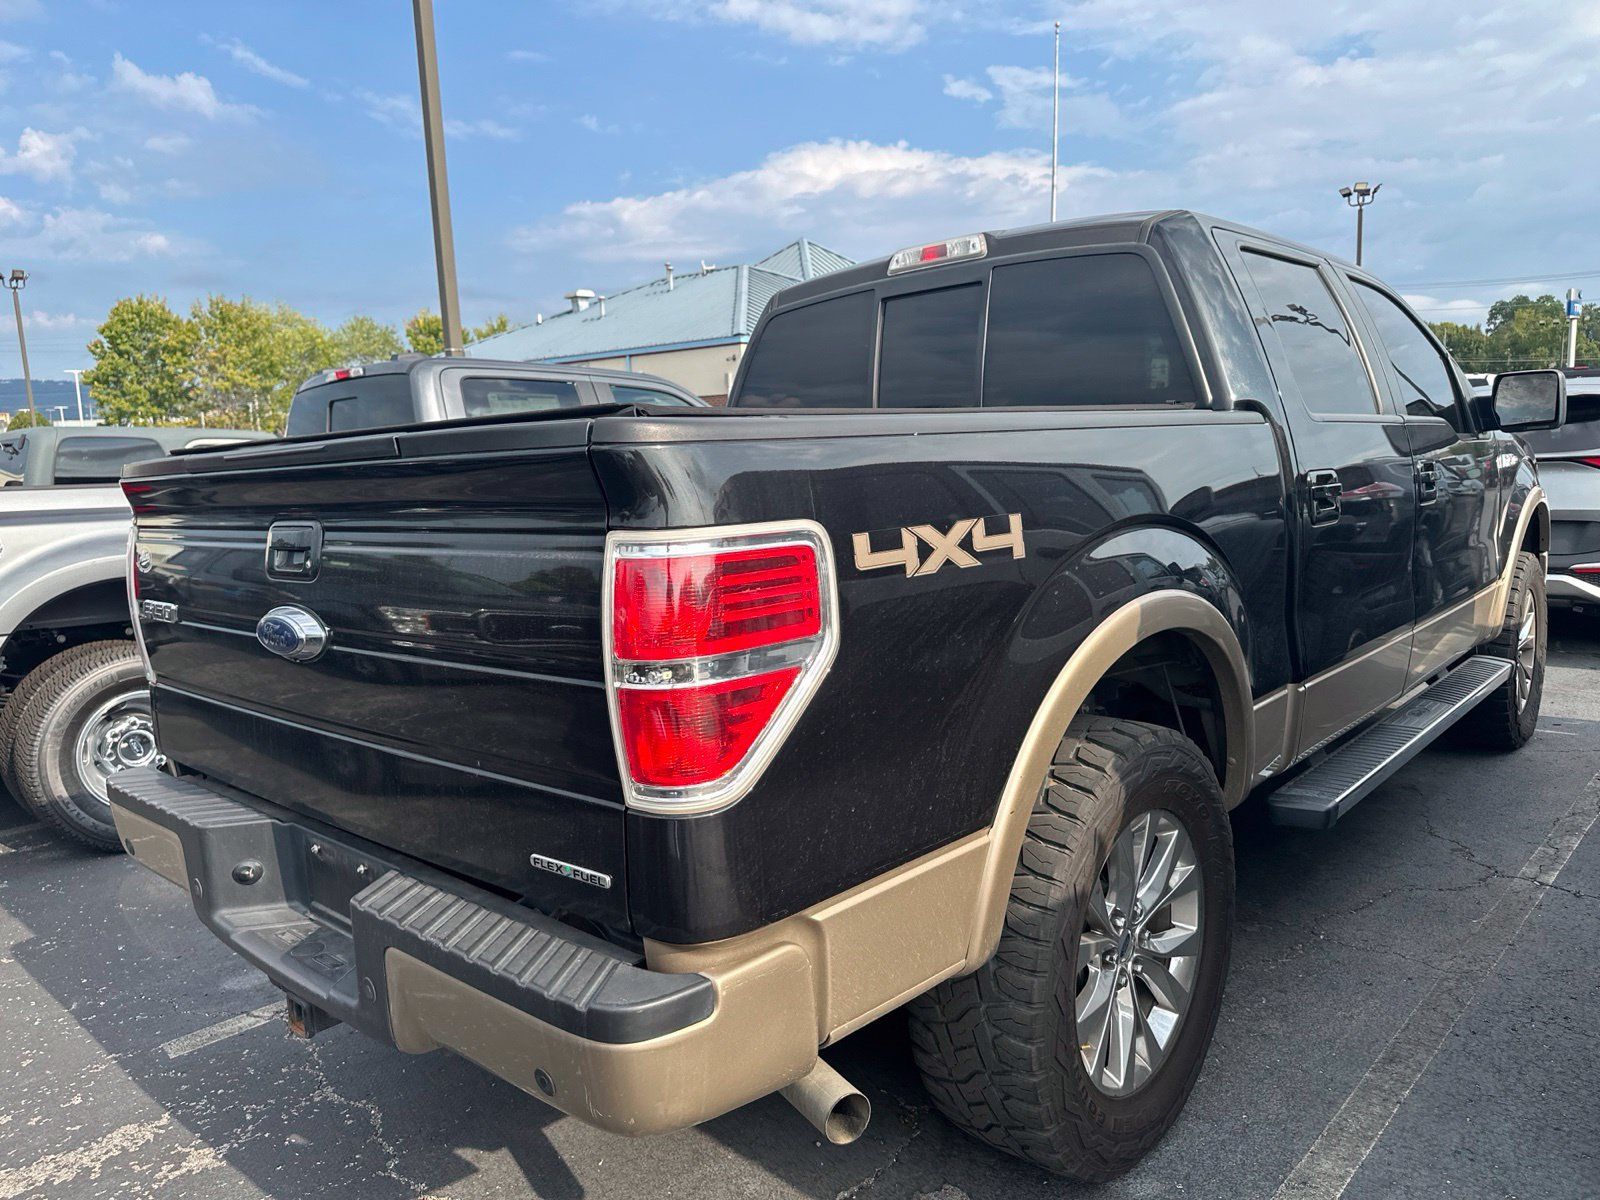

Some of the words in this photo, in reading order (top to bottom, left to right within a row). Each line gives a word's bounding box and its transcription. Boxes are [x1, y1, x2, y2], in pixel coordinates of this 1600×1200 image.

[852, 513, 1026, 578] 4X4
[261, 620, 293, 649] Ford
[533, 857, 563, 874] FLEX
[573, 869, 605, 887] FUEL
